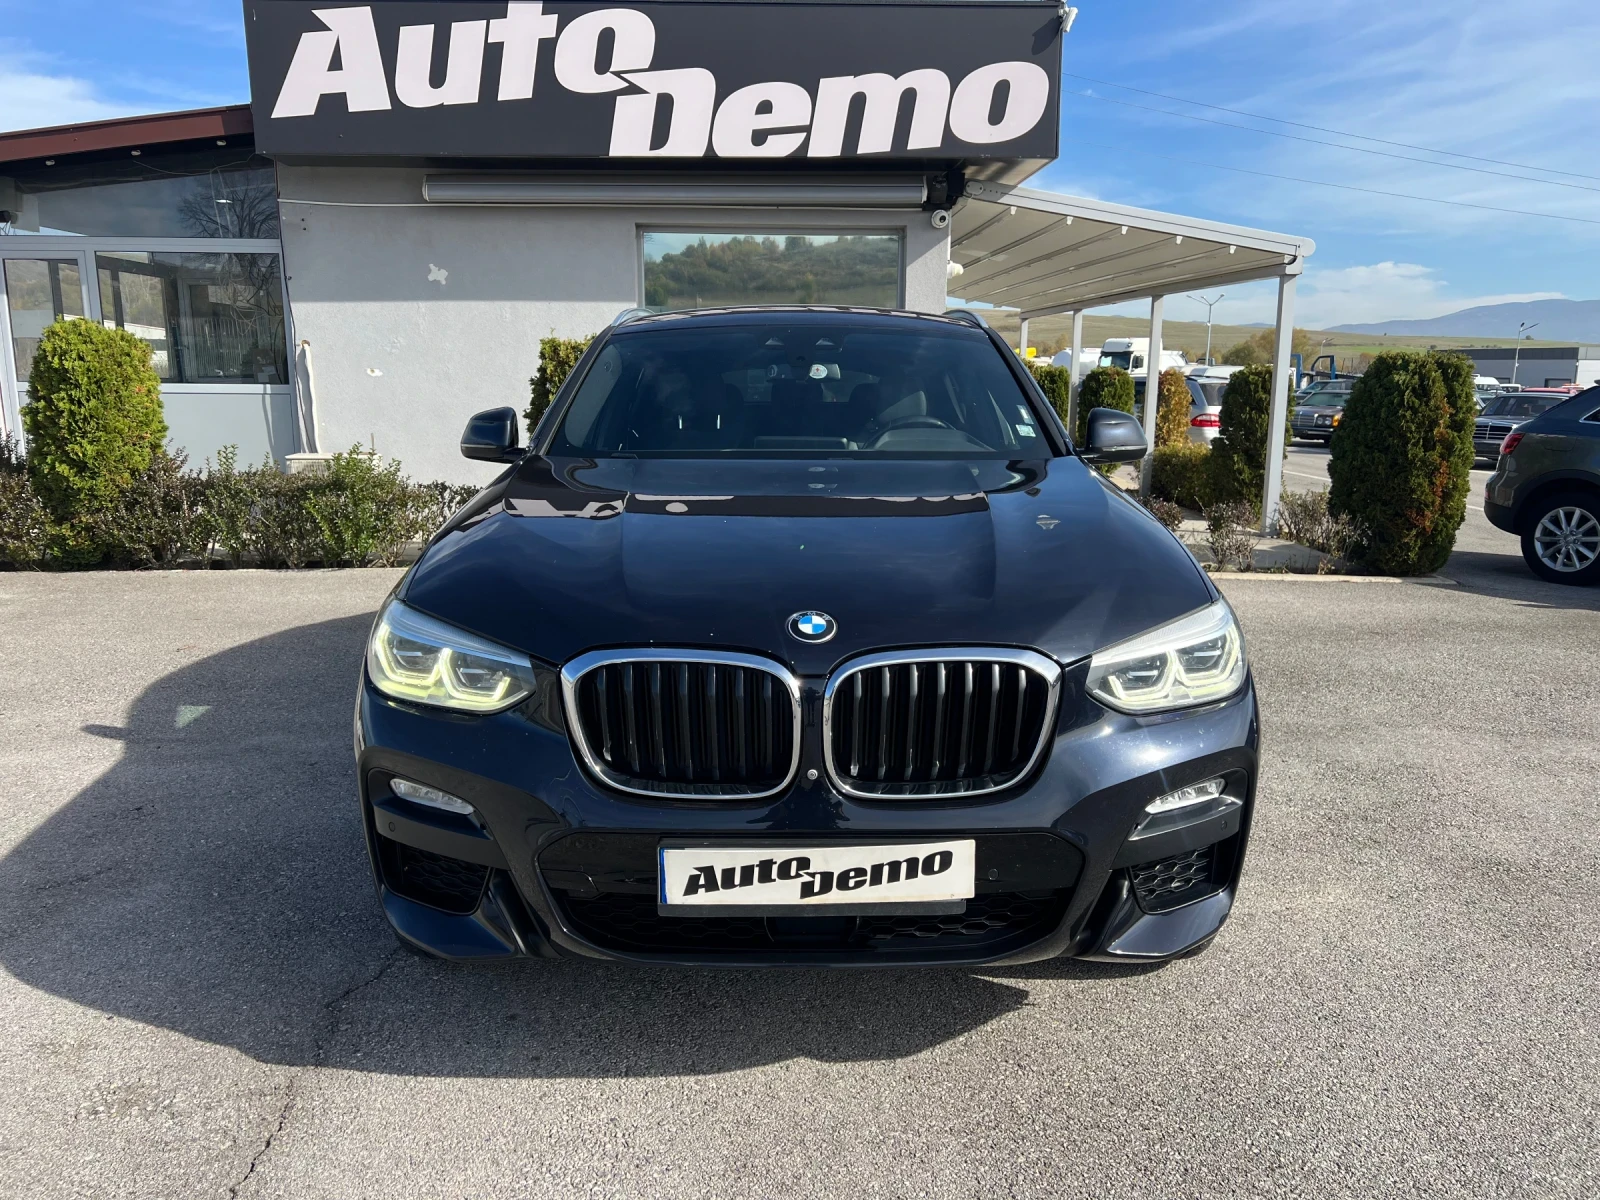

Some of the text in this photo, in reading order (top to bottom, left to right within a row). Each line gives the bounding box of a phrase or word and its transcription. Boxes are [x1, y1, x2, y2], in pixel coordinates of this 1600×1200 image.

[271, 1, 1050, 158] Auto Demo
[682, 850, 953, 899] Auto Demo
